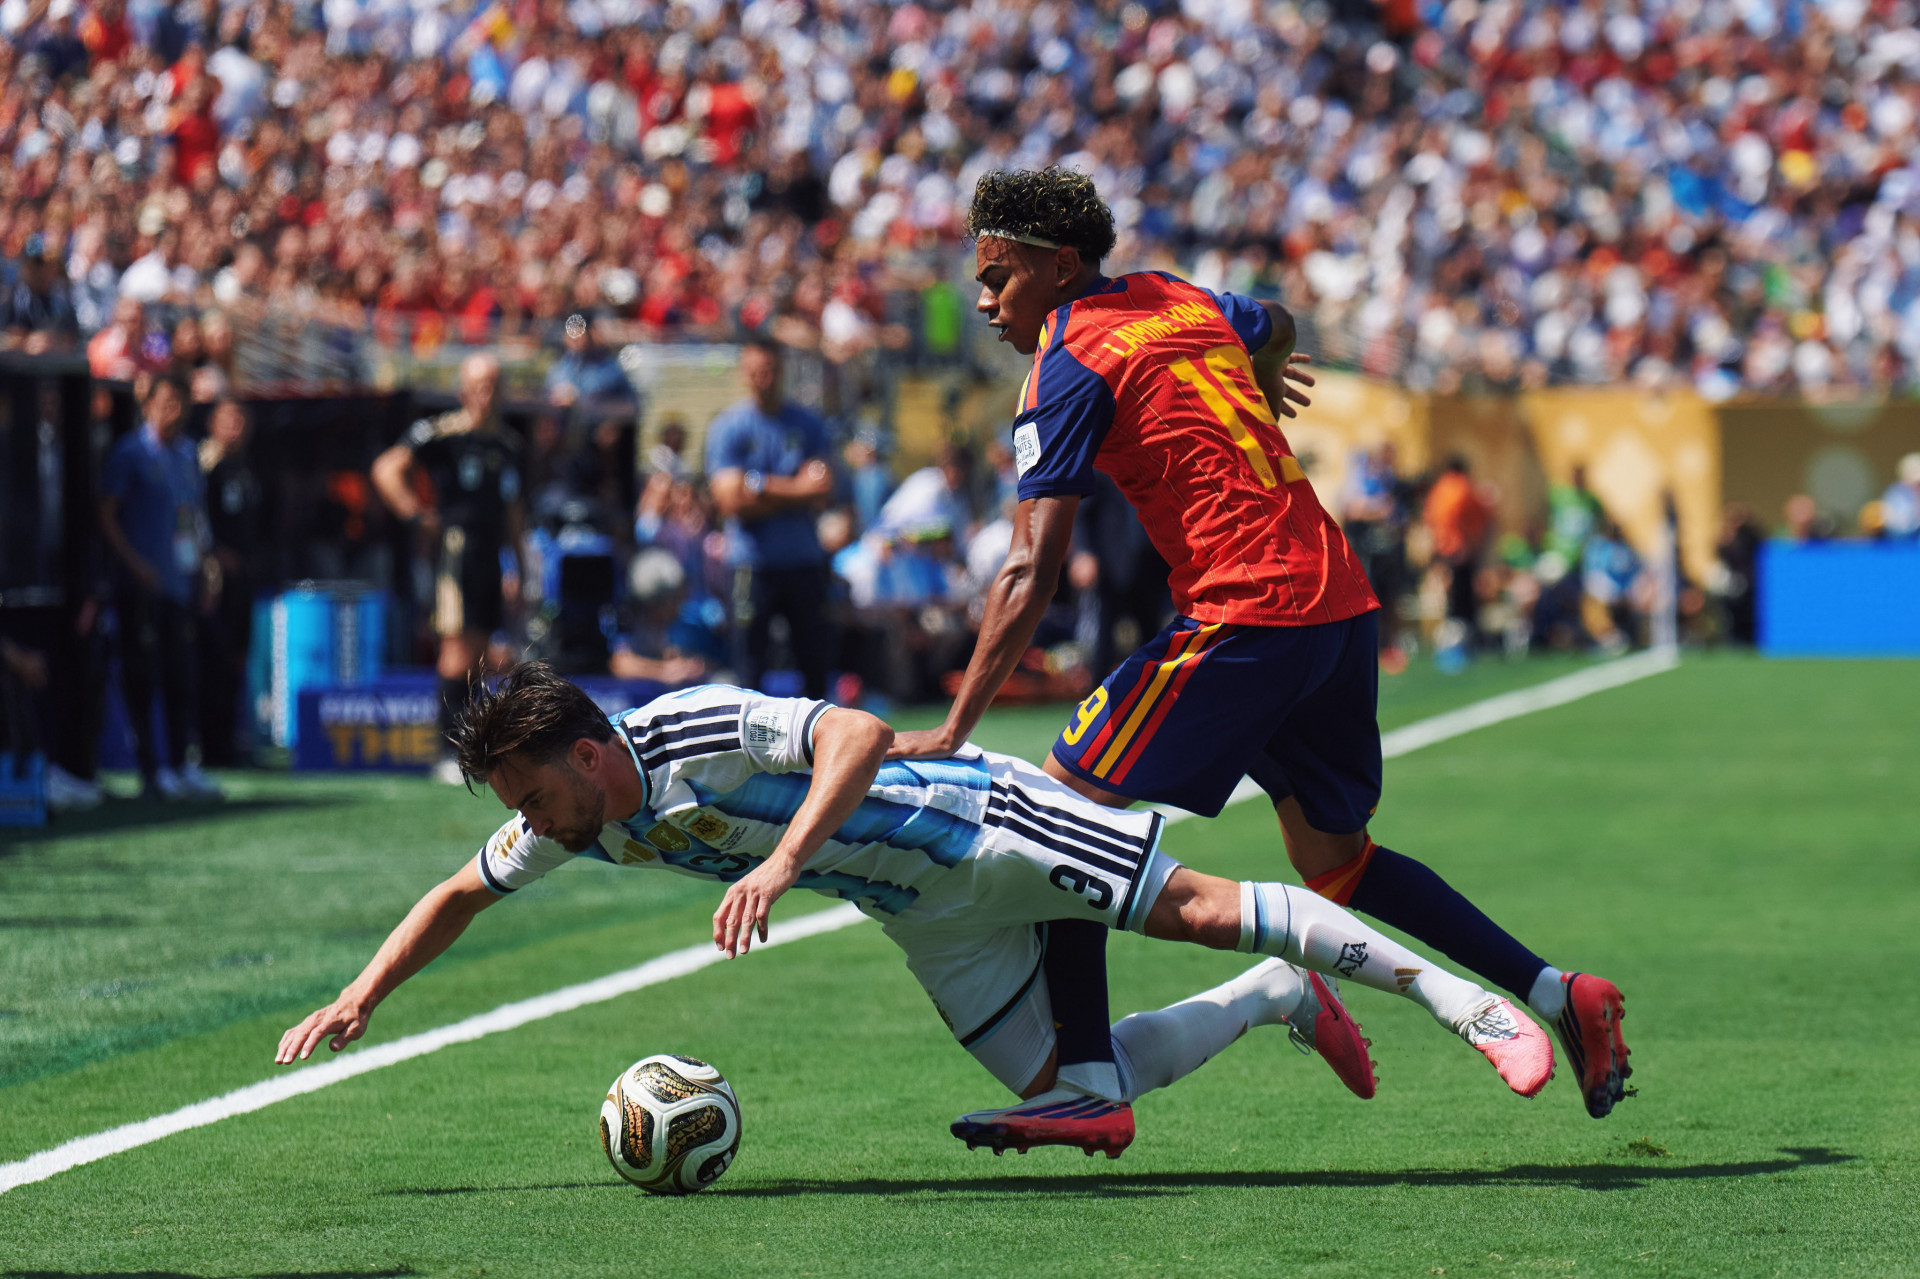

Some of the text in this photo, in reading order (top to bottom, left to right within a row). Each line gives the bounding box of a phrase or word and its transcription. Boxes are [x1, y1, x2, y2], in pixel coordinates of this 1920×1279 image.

[1101, 299, 1218, 359] LAMINE YAM
[1168, 344, 1307, 489] 19
[1016, 439, 1033, 454] NITES
[757, 715, 769, 742] UNITES
[1063, 685, 1108, 746] 9
[330, 724, 438, 765] THE
[688, 853, 750, 872] 3
[1049, 864, 1113, 910] 3
[1333, 942, 1368, 977] AFA
